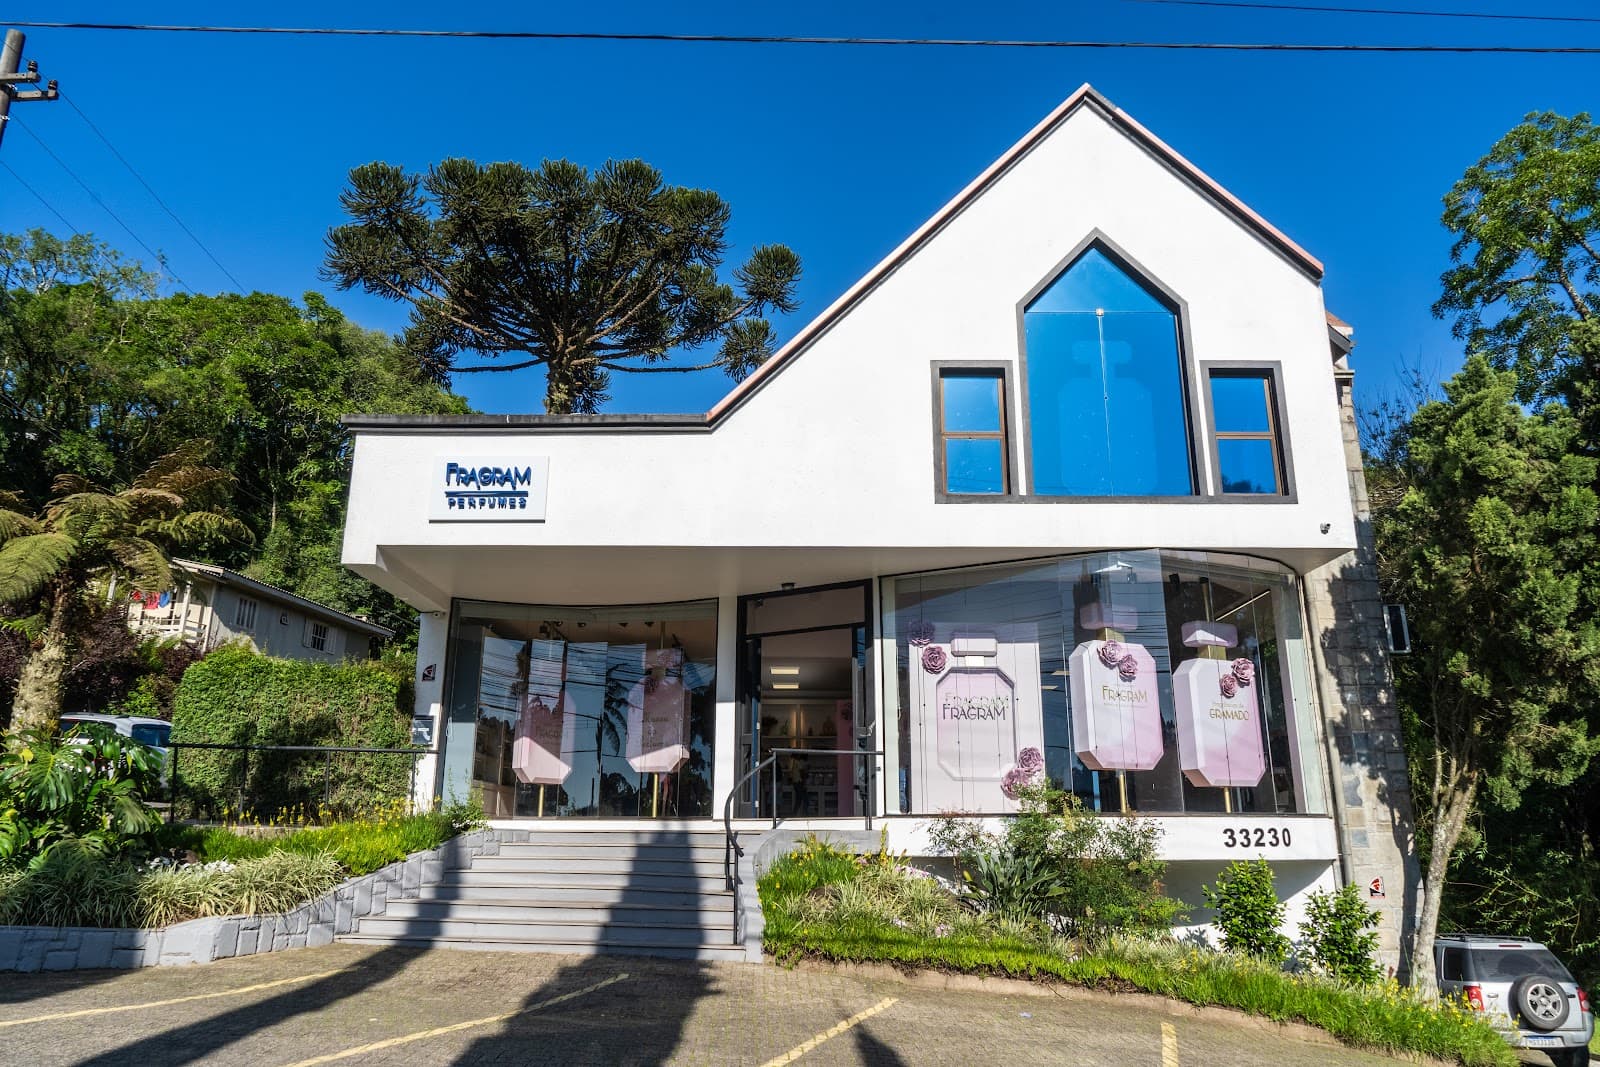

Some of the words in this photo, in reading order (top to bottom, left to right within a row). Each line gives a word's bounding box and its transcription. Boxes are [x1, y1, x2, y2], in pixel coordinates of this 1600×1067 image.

[446, 462, 532, 490] FRAGRAM
[447, 497, 527, 510] PERFUMES
[1102, 685, 1148, 703] FRAGRAM
[943, 703, 1006, 721] FRAGRAM
[1209, 708, 1249, 721] GRAMADO
[1222, 827, 1292, 848] 33230
